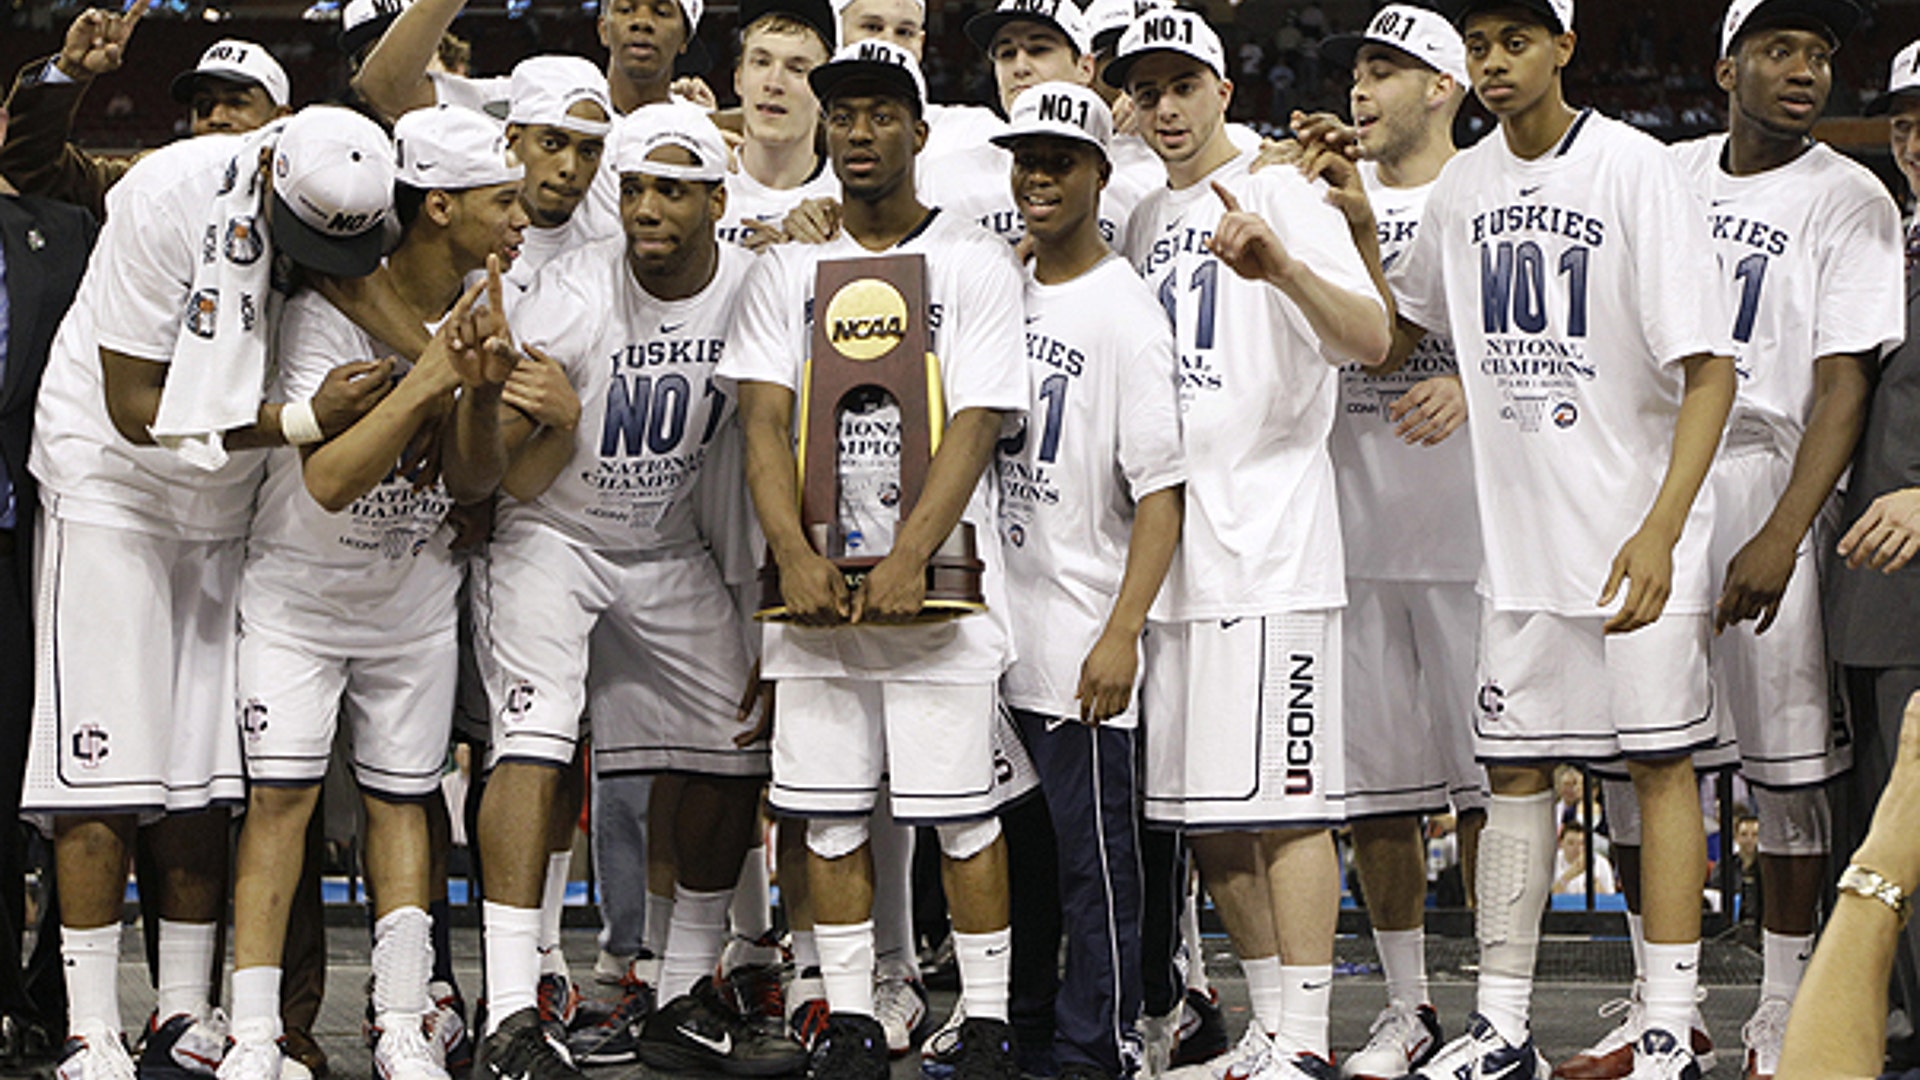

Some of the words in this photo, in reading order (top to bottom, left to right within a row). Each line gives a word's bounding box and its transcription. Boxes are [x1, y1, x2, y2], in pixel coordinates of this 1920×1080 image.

[1143, 15, 1193, 44] NO.1
[1373, 12, 1415, 41] NO.1
[1038, 93, 1088, 129] NO.1
[1472, 205, 1605, 247] HUSKIES
[1707, 214, 1790, 256] KIES
[1480, 240, 1549, 334] NO
[1558, 245, 1590, 337] 1
[1733, 252, 1769, 343] 1
[832, 316, 905, 342] NCAA
[601, 373, 690, 457] NO
[1284, 654, 1314, 796] UCONN
